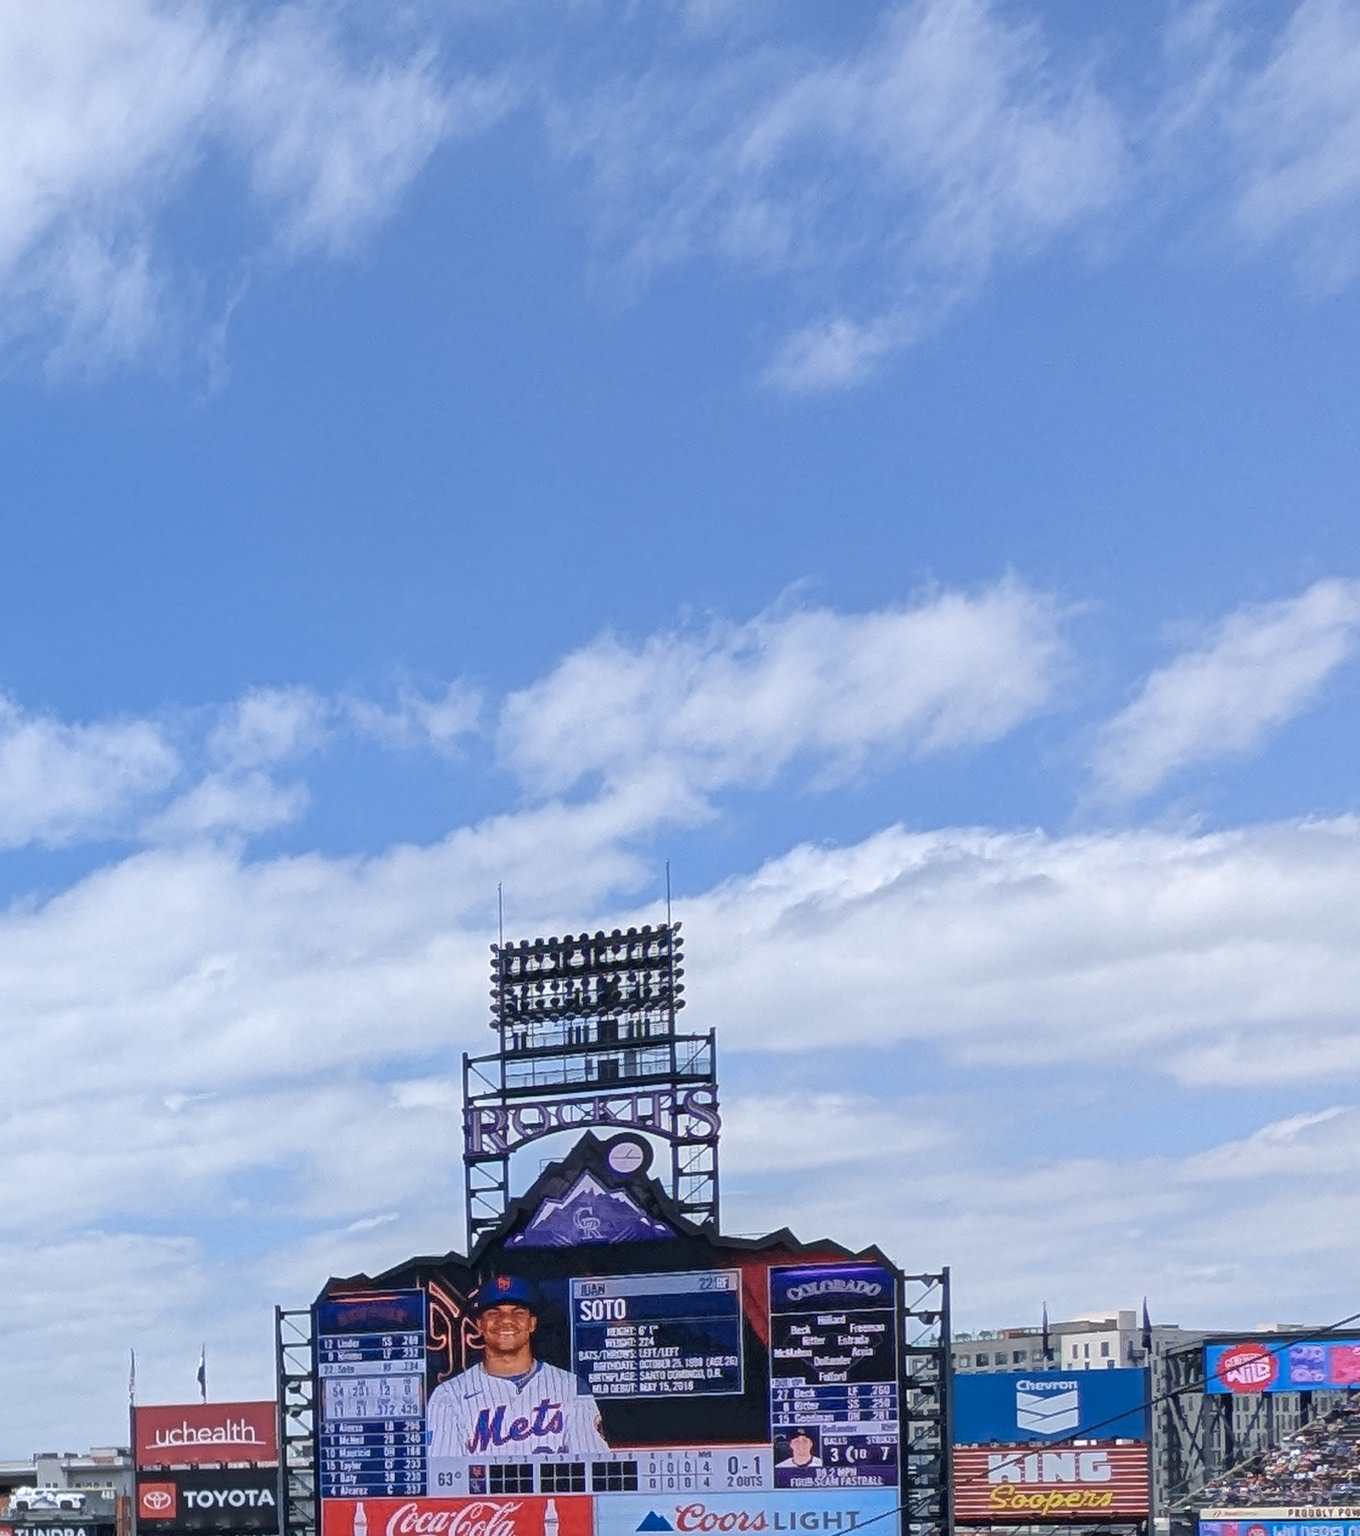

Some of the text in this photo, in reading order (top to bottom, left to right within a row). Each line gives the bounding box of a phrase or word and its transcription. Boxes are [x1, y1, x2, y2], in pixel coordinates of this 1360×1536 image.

[465, 1087, 721, 1153] ROCKIES
[581, 1283, 605, 1296] JUAN
[699, 1277, 728, 1290] 22 RF
[787, 1280, 881, 1301] COLORADO
[580, 1298, 626, 1321] SOTO
[1016, 1379, 1077, 1391] Chevron
[155, 1418, 256, 1446] uchealth
[465, 1397, 564, 1454] Mets
[438, 1471, 461, 1486] 63°
[987, 1452, 1111, 1483] KING
[737, 1476, 762, 1486] OUTS
[183, 1489, 275, 1507] TOYOTA
[989, 1485, 1113, 1514] Soopers
[675, 1502, 860, 1532] Coors LIGHT
